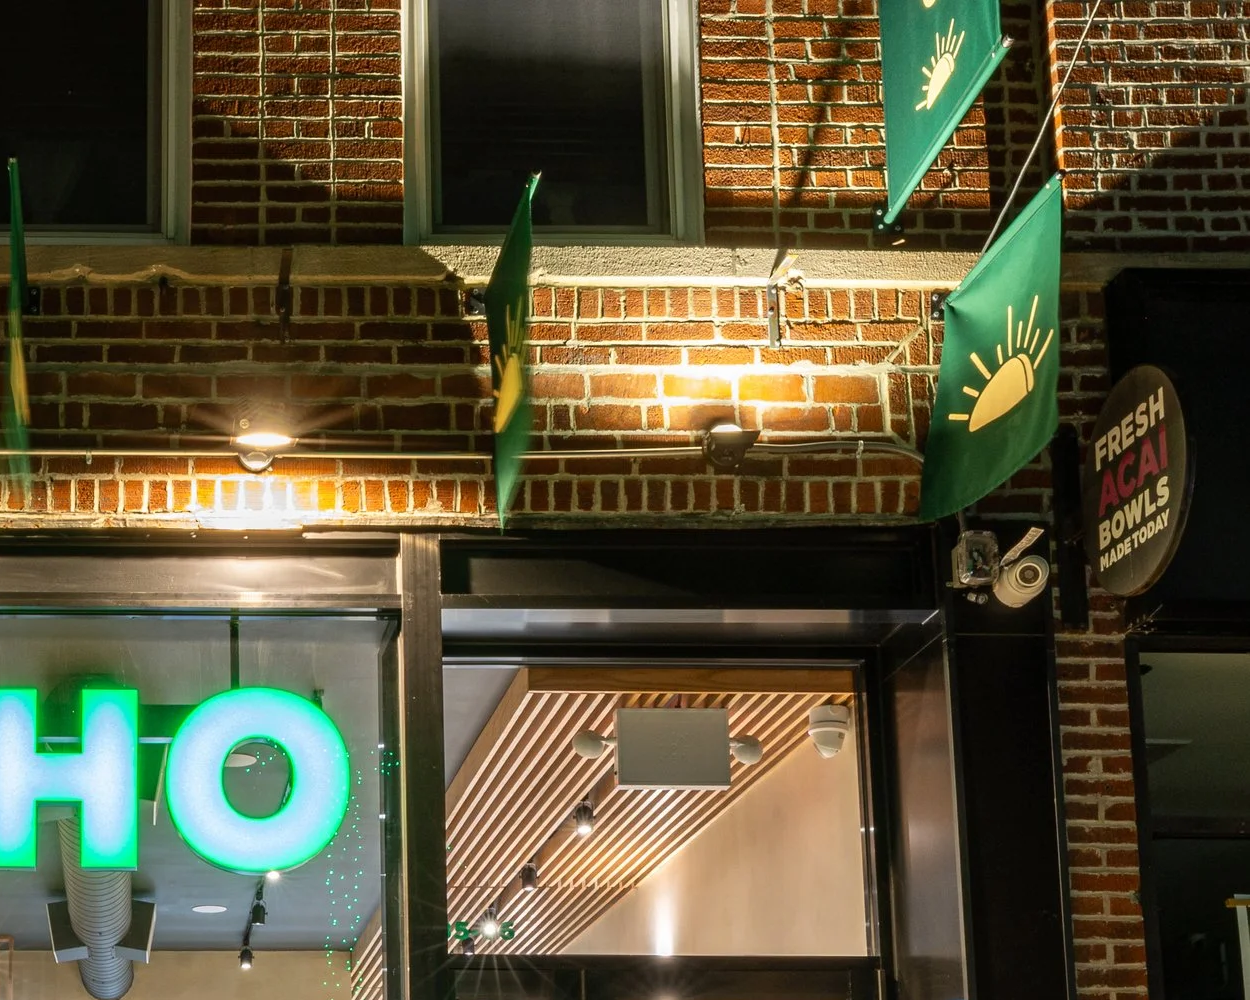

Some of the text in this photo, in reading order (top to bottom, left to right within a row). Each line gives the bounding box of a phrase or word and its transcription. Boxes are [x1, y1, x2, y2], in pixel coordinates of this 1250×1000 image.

[1095, 386, 1165, 472] FRESH
[1098, 423, 1169, 517] ACAI
[1099, 475, 1170, 550] BOWLS
[1100, 508, 1170, 572] MADE TODAY
[447, 921, 515, 940] 5-6
